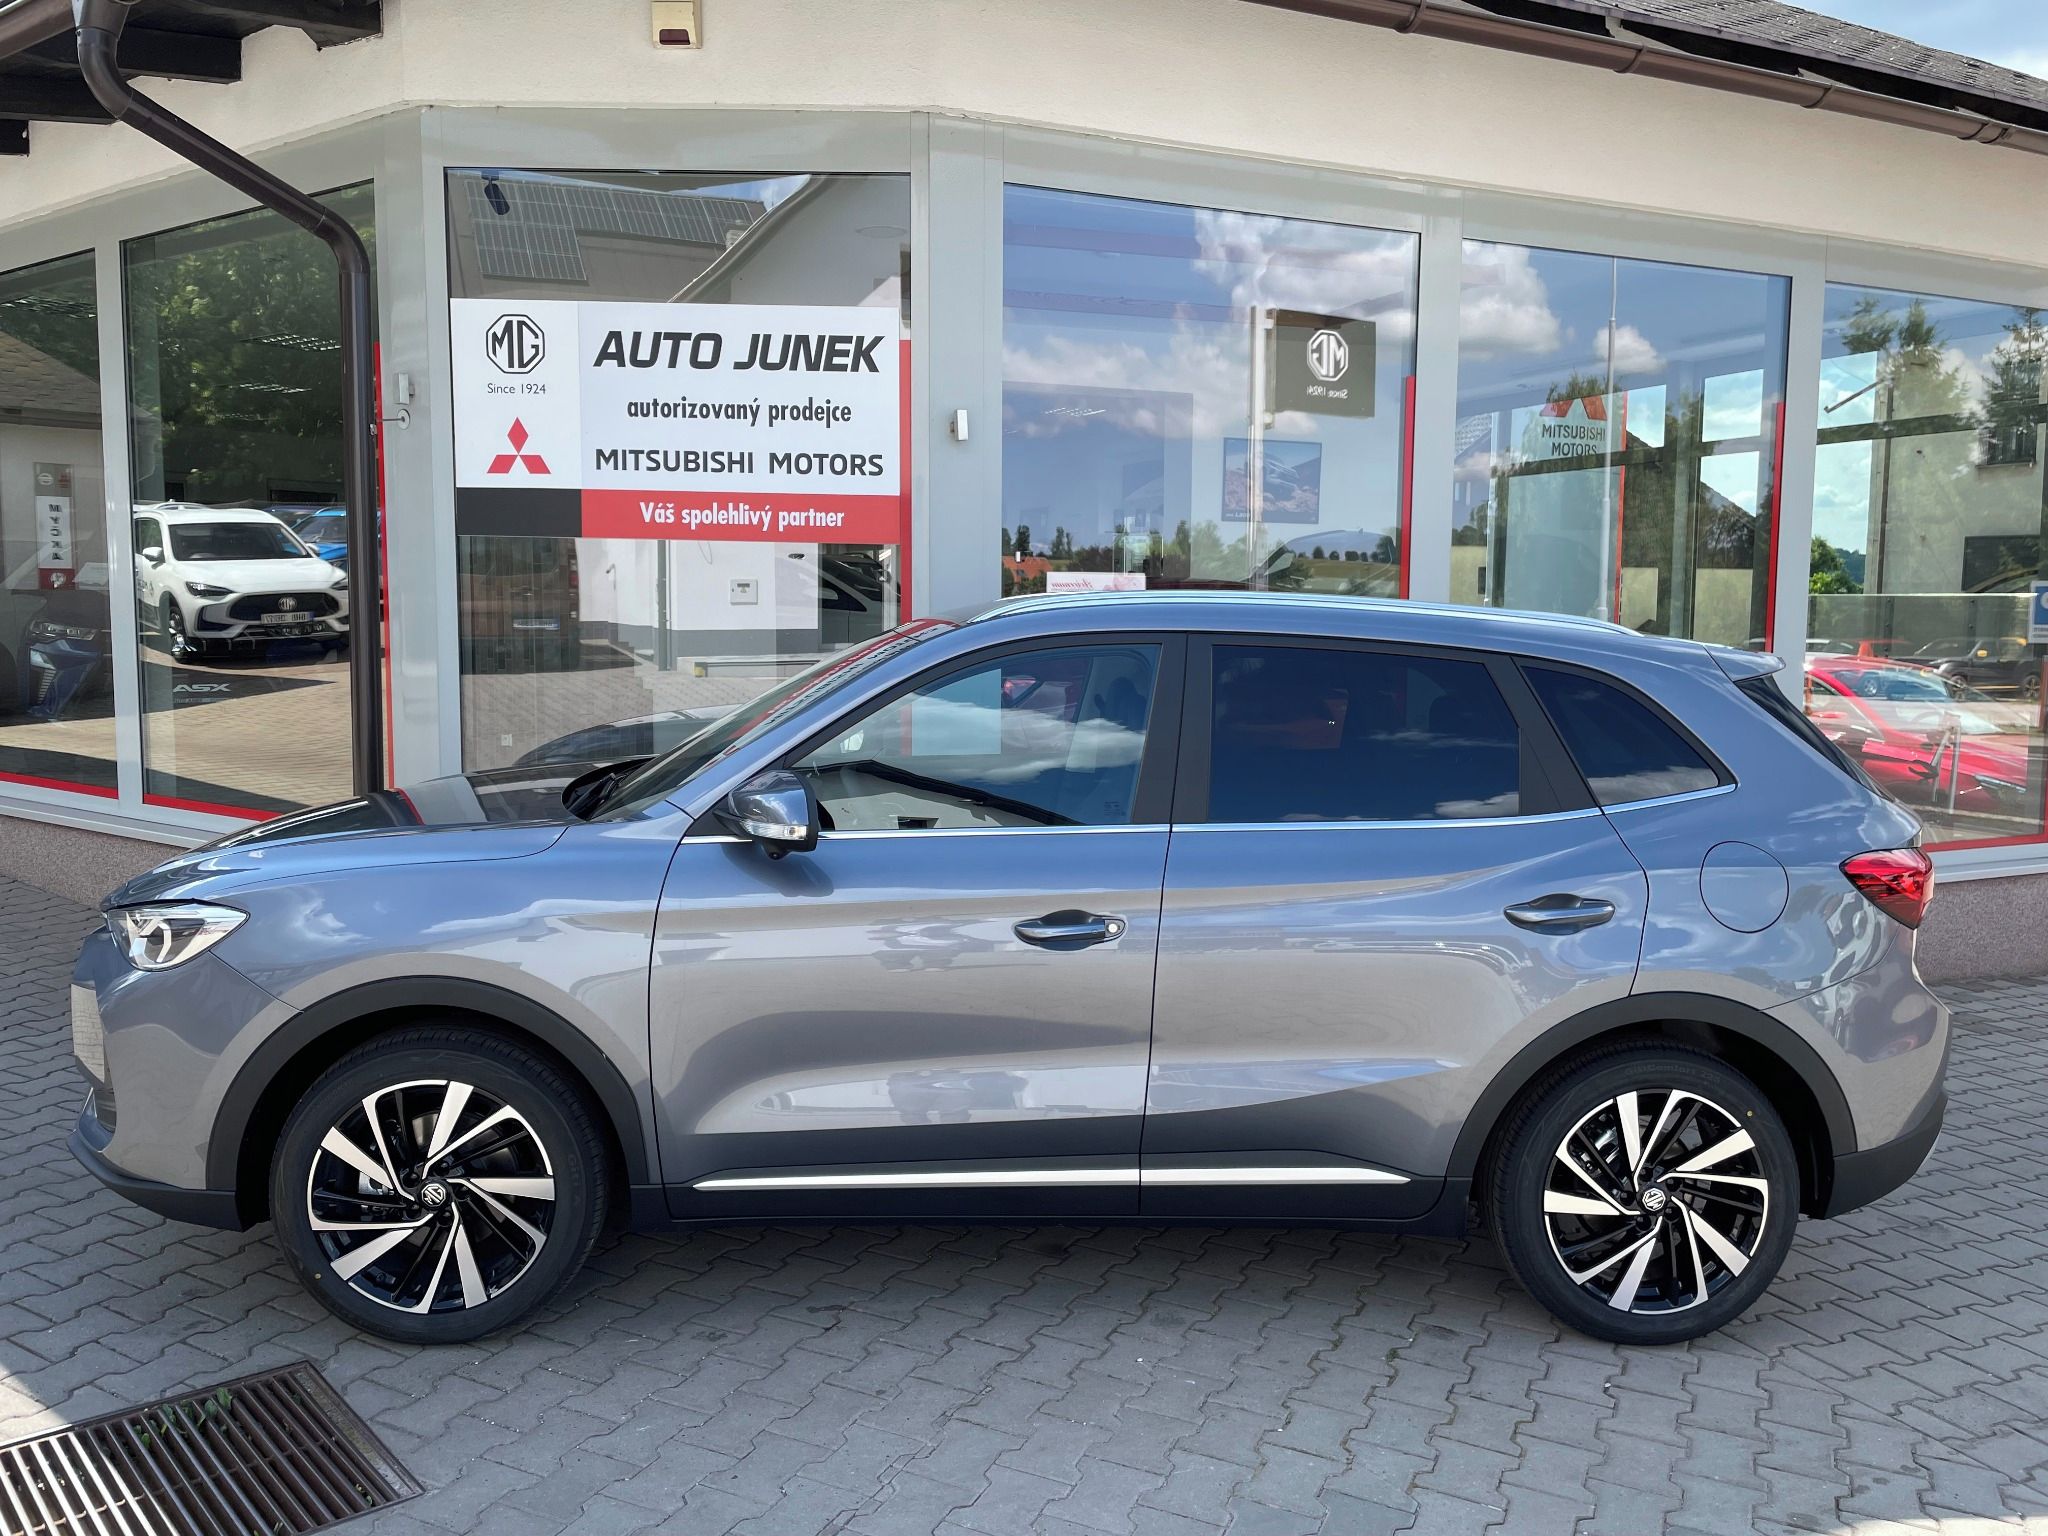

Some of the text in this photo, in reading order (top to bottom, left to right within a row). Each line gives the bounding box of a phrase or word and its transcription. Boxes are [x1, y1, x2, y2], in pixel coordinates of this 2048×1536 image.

[489, 317, 541, 370] MG
[593, 331, 885, 373] AUTO JUNEK
[487, 382, 546, 395] Since 1924
[627, 396, 852, 429] autorizovaný prodejce
[1541, 423, 1607, 441] MITSUBISHI
[1551, 441, 1598, 457] MOTORS
[595, 448, 885, 477] MITSUBISHI MOTORS
[639, 501, 845, 532] Váš spolehlivý partner
[173, 683, 231, 693] ASX
[423, 1185, 445, 1205] MG
[1643, 1190, 1665, 1210] MG
